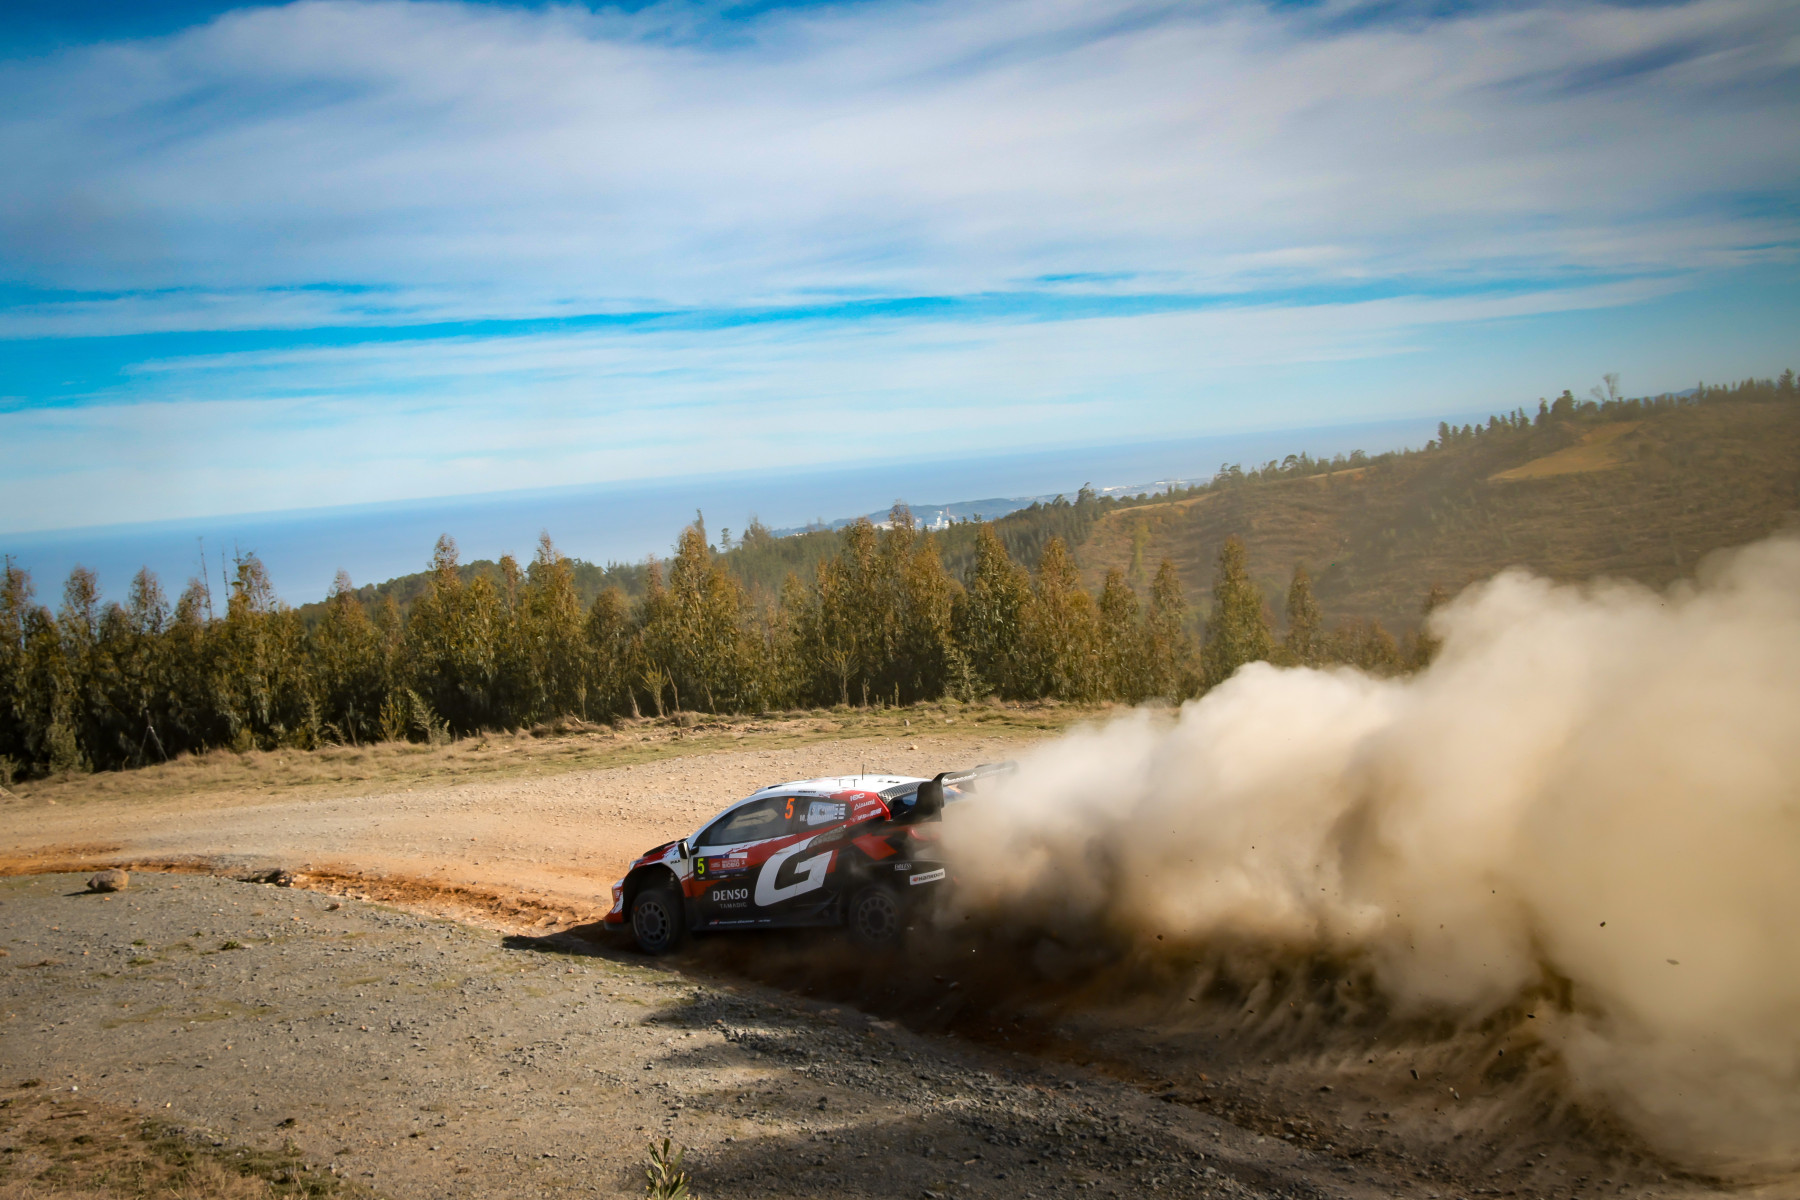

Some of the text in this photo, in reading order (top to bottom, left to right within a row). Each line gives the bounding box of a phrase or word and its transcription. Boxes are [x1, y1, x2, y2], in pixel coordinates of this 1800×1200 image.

[785, 798, 795, 819] 5
[697, 858, 705, 874] 5
[713, 888, 748, 901] DENSO
